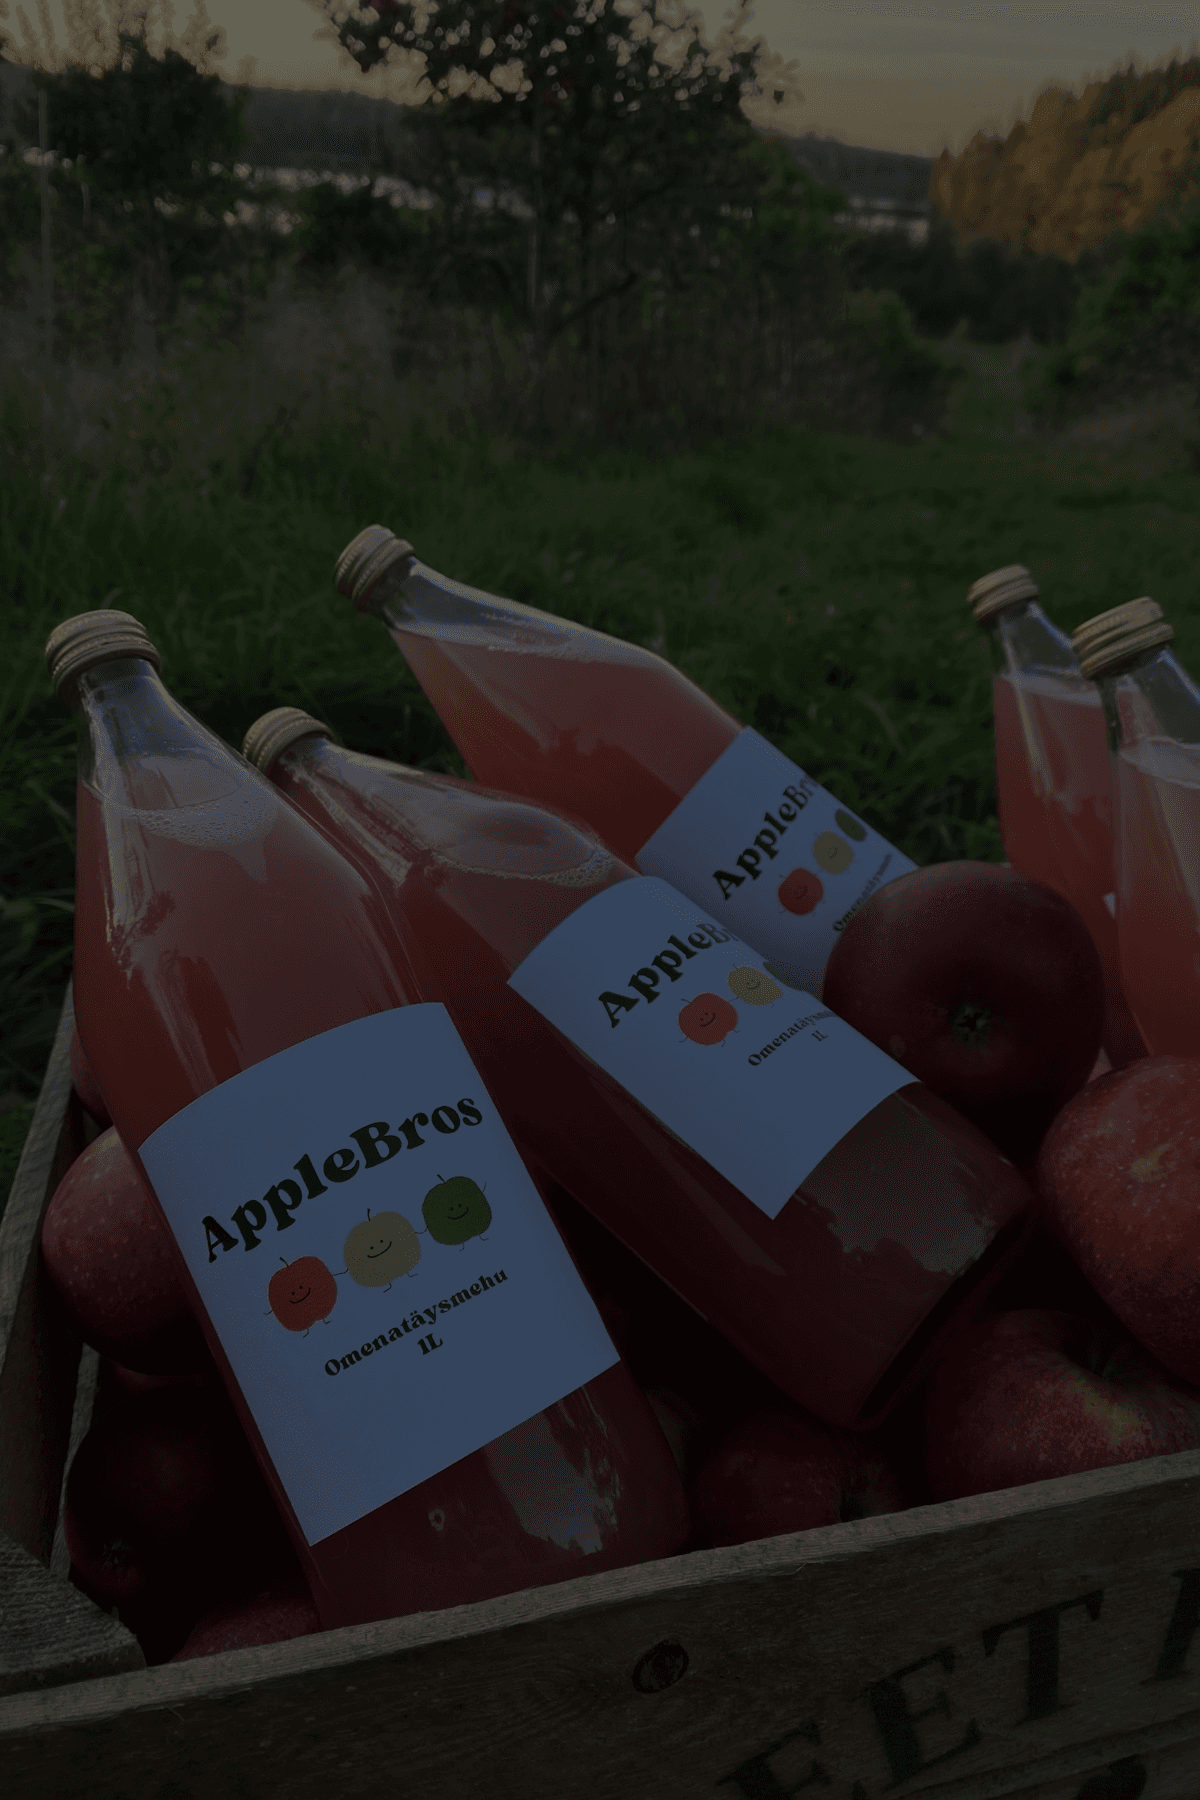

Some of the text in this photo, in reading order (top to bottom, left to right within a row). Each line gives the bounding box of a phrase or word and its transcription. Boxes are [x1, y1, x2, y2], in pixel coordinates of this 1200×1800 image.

[811, 1030, 828, 1042] 1L
[202, 1097, 483, 1264] AppleBros
[324, 1269, 508, 1377] Omenatäysmehu
[417, 1333, 444, 1356] 1L
